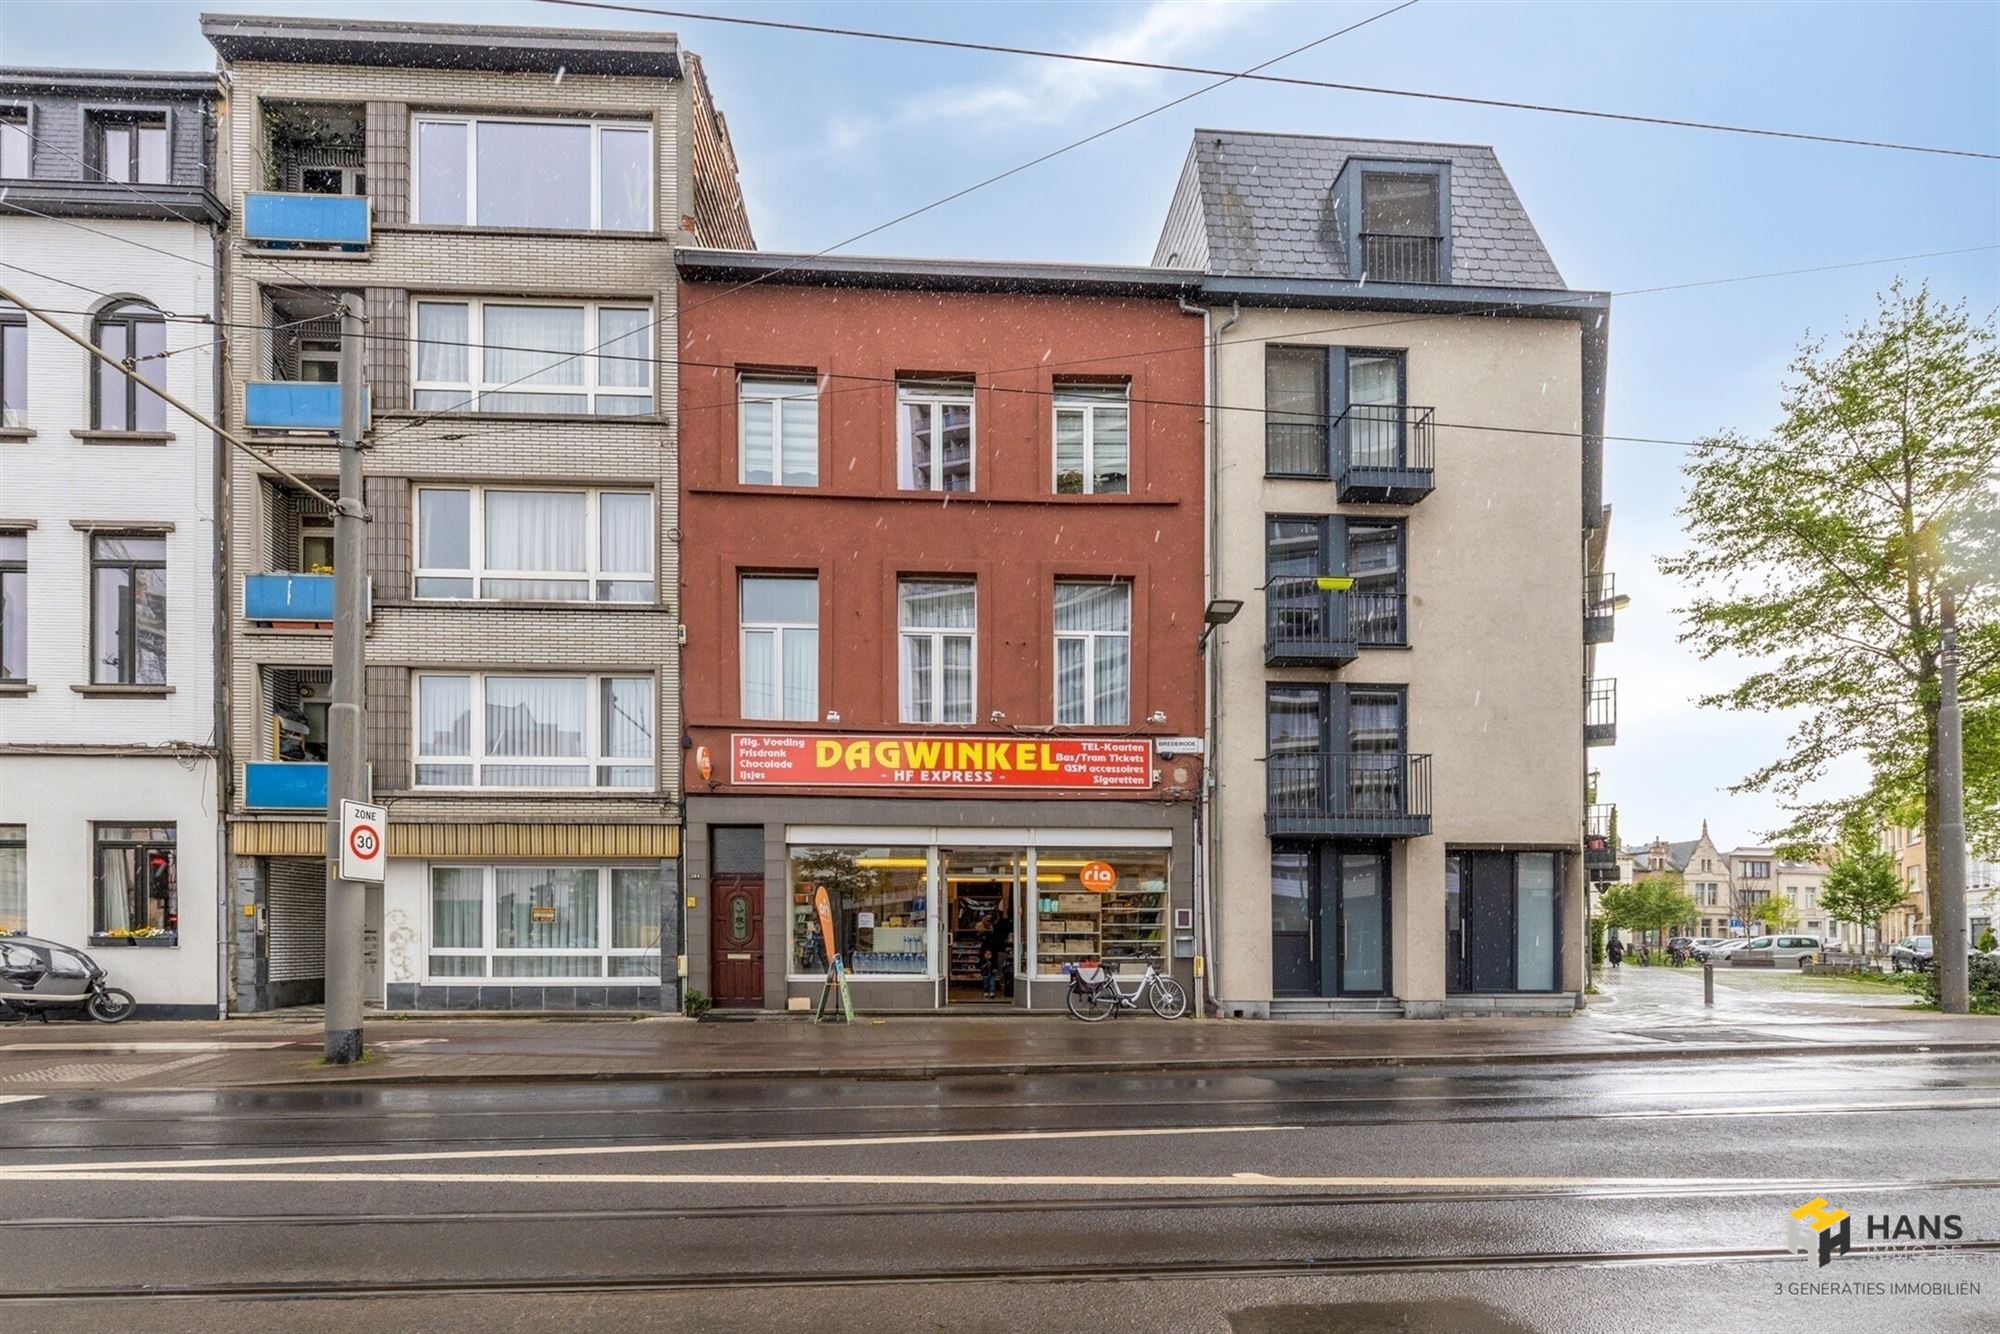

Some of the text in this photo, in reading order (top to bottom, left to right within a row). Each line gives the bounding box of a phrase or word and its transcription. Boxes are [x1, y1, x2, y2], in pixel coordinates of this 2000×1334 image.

[763, 738, 805, 748] Voeding
[1081, 742, 1144, 752] TEL-Kaarten
[740, 749, 786, 757] Frisdrank
[816, 740, 1059, 771] DAGWINKEL
[1109, 754, 1144, 763] Tickets
[740, 760, 793, 768] Chocolade
[1064, 764, 1144, 773] GSM accessoires
[894, 770, 914, 782] HF
[921, 771, 992, 783] EXPRESS
[1093, 775, 1144, 785] Sigaretten
[354, 808, 376, 821] ZONE
[357, 836, 373, 850] 30
[1085, 865, 1111, 881] ria
